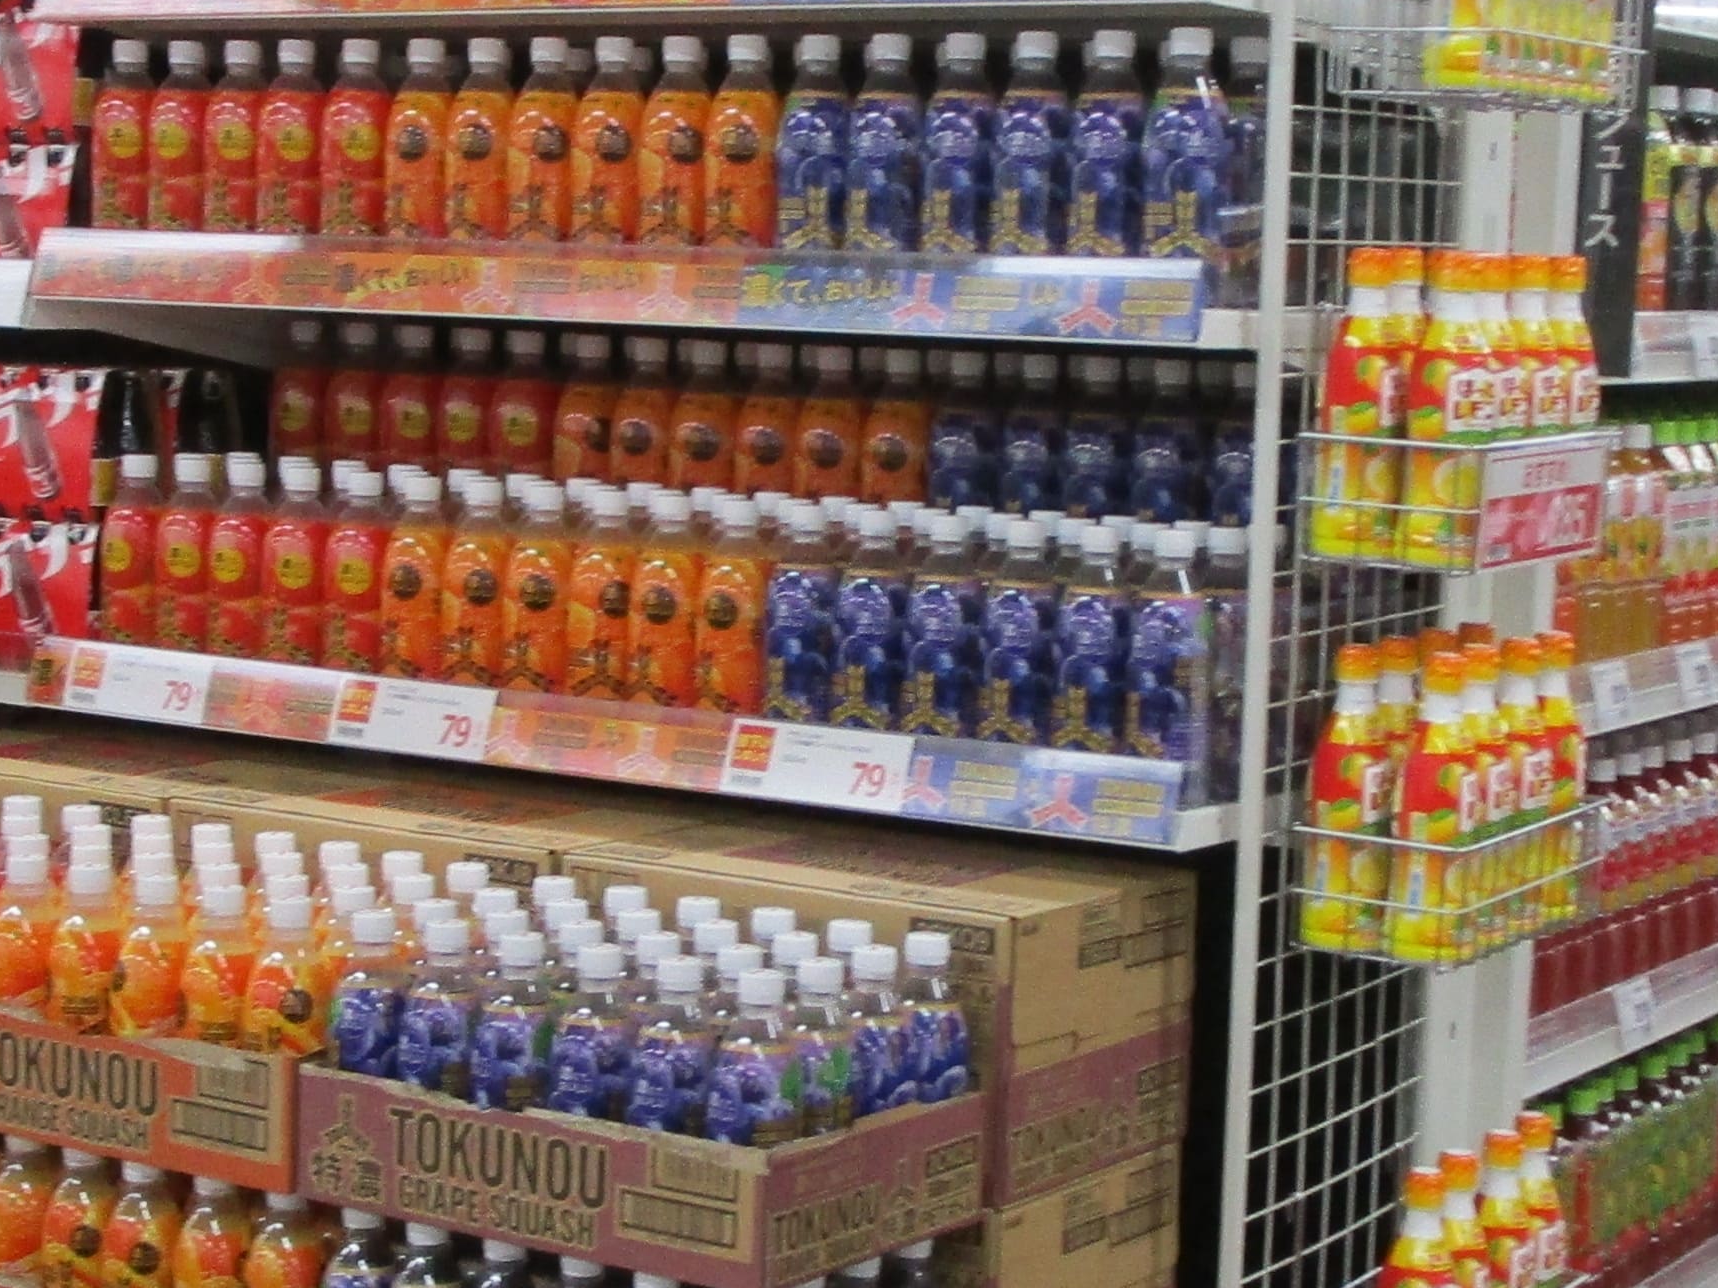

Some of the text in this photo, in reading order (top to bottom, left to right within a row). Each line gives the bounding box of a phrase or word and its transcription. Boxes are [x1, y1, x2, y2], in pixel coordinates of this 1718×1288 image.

[162, 680, 193, 712] 79
[437, 713, 474, 748] 79
[848, 760, 886, 797] 79
[390, 1107, 607, 1210] TOKUNOU
[397, 1174, 596, 1248] GRAPE SQUASH
